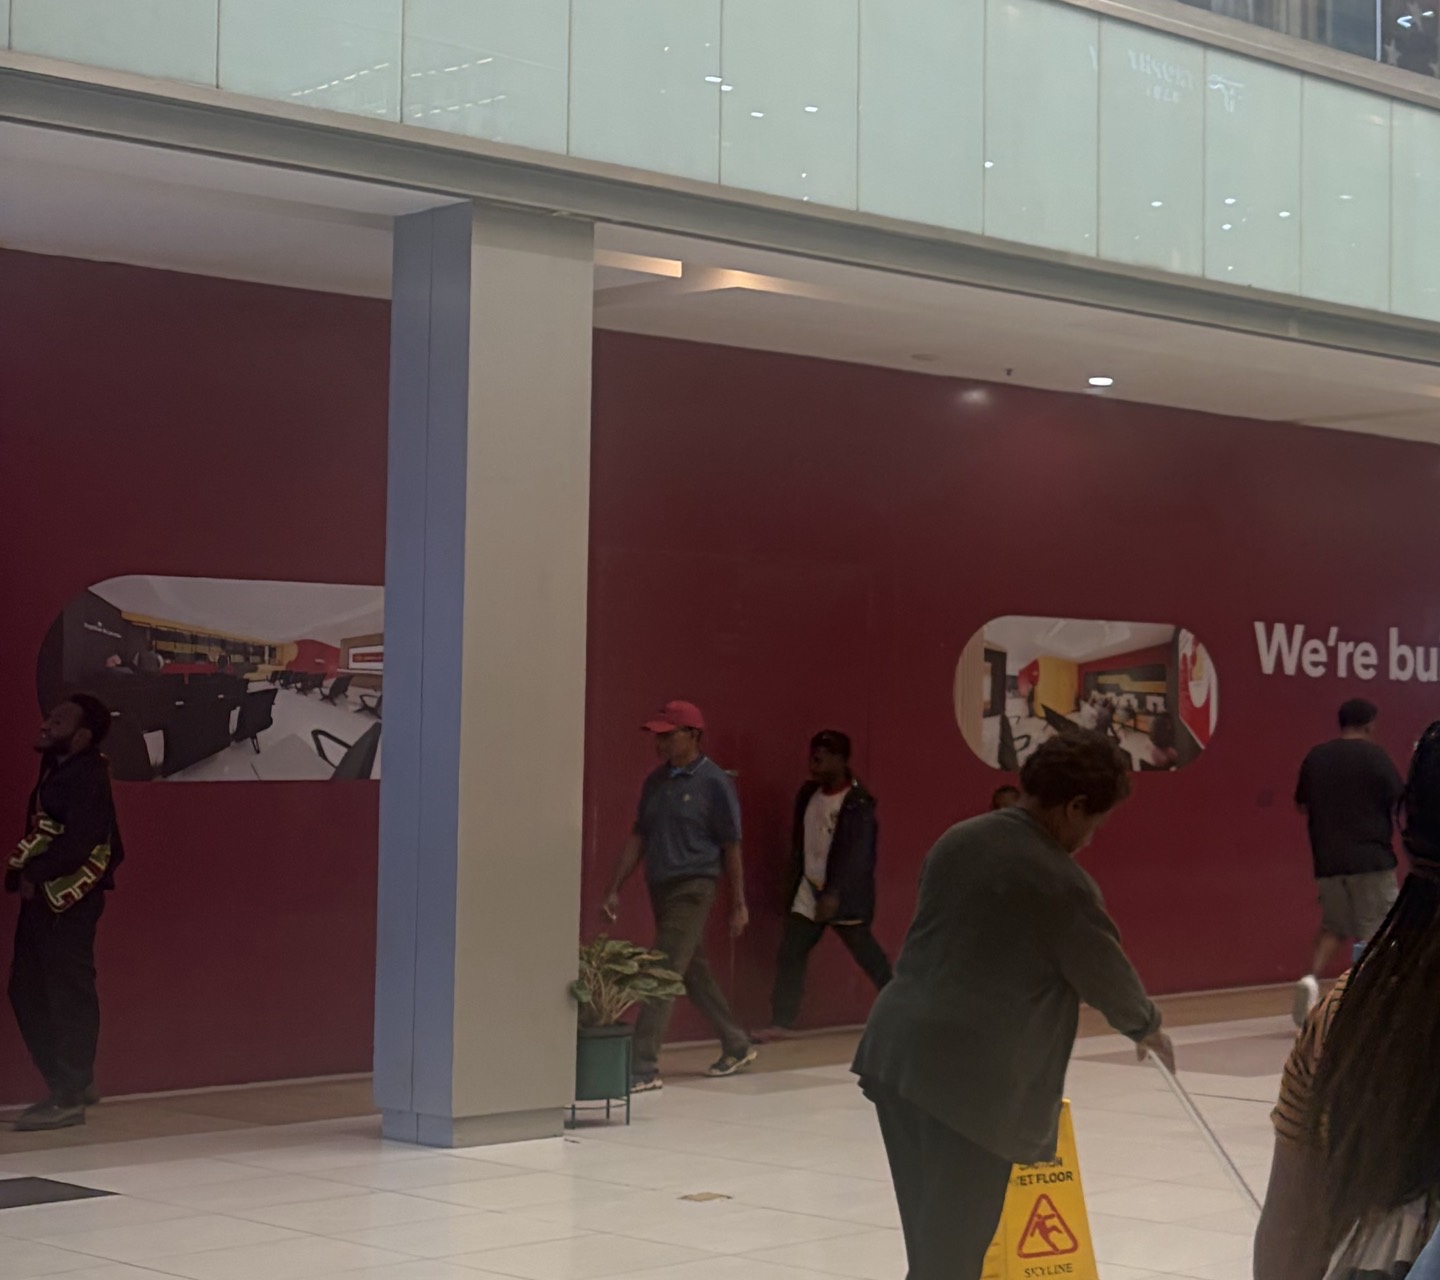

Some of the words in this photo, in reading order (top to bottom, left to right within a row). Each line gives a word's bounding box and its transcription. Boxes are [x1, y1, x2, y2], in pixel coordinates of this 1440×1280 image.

[1253, 621, 1379, 680] We're
[1016, 1174, 1033, 1186] ET
[1036, 1171, 1073, 1184] FLOOR
[1024, 1263, 1073, 1278] SKYLINE
